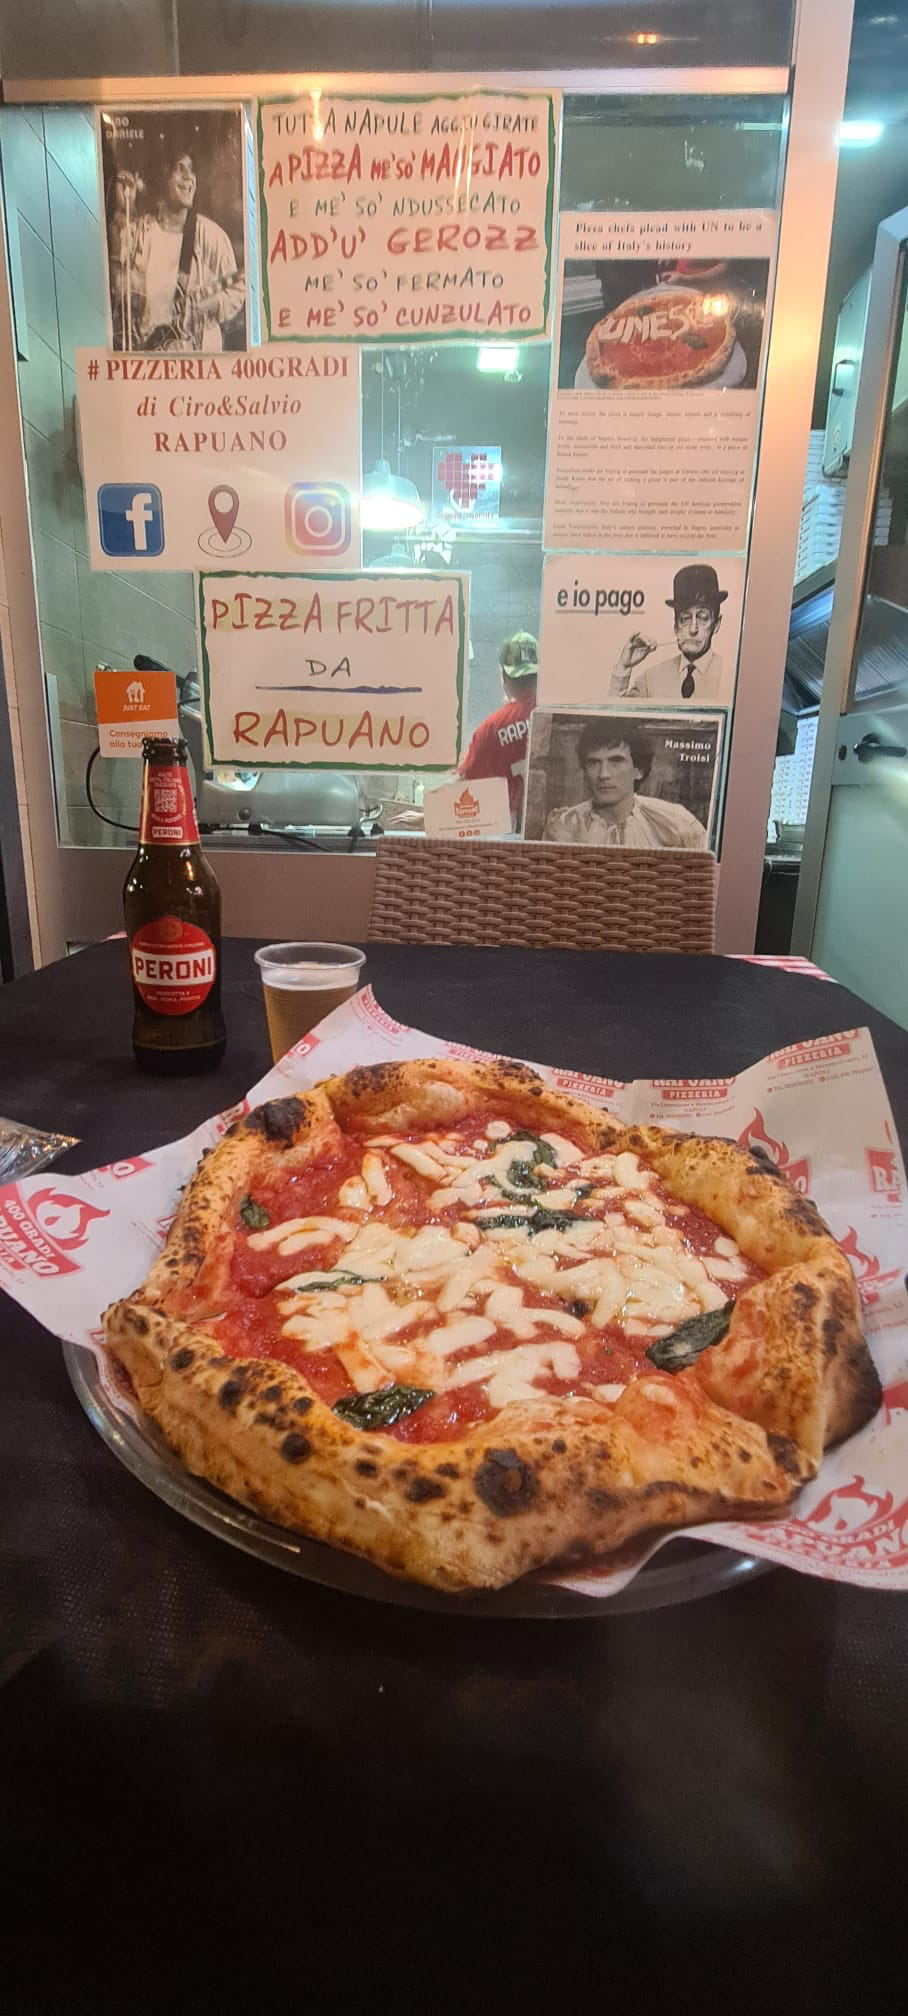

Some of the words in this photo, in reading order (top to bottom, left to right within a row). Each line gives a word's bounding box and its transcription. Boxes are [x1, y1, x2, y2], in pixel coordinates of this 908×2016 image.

[344, 108, 422, 135] NAPULE
[269, 161, 284, 188] A
[287, 143, 362, 184] PIZZA
[420, 141, 542, 183] MANGIATO
[289, 198, 299, 218] E
[674, 222, 696, 233] with
[702, 221, 719, 232] UN
[723, 222, 734, 232] to
[386, 223, 540, 256] GEROZZ
[602, 240, 612, 251] of
[655, 240, 693, 254] history
[396, 268, 505, 292] FERMATO
[278, 308, 291, 328] E
[394, 299, 533, 328] CUNZULATO
[106, 359, 222, 380] PIZZERIA
[231, 355, 349, 378] 400GRADI
[137, 397, 157, 417] di
[169, 394, 302, 417] Ciro&Salvio
[154, 430, 287, 452] RAPUANO
[557, 589, 568, 607] e
[573, 580, 590, 607] io
[595, 589, 645, 615] pago
[211, 593, 322, 634] PIZZA
[337, 594, 454, 636] FRITTA
[305, 657, 351, 678] DA
[233, 709, 430, 748] RAPUANO
[664, 740, 711, 750] Massimo
[680, 753, 710, 763] Troisi
[153, 828, 181, 836] PERONI
[134, 955, 212, 980] PERONI
[783, 1046, 842, 1067] PIZZERIA
[669, 1089, 721, 1099] PIZZERIA
